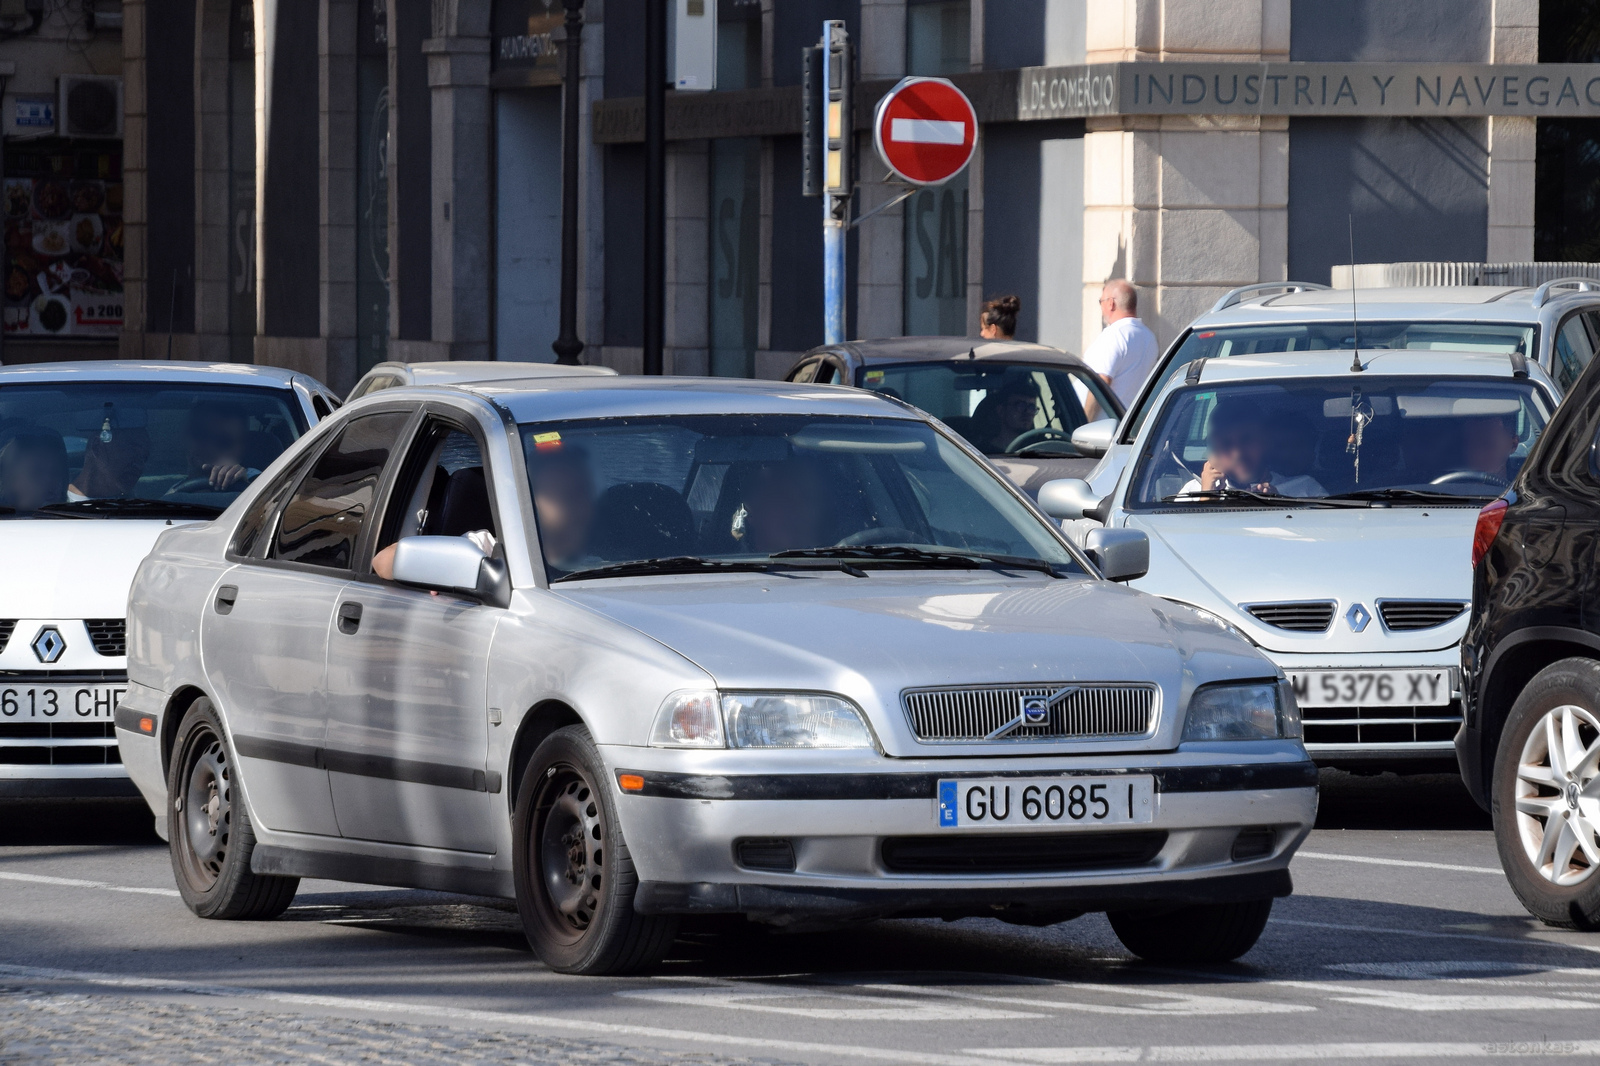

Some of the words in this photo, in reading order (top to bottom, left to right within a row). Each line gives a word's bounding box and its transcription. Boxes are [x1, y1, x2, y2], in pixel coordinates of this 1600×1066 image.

[1030, 79, 1047, 110] DE
[1049, 74, 1114, 110] COMERCIO
[1133, 73, 1358, 106] INDUSTRIA
[1372, 75, 1395, 106] Y
[1, 688, 59, 717] 613
[1320, 673, 1395, 703] 5376
[1407, 673, 1443, 702] XY
[944, 809, 954, 820] E
[965, 785, 1011, 821] GU
[1021, 784, 1110, 821] 6085
[1127, 783, 1134, 819] I
